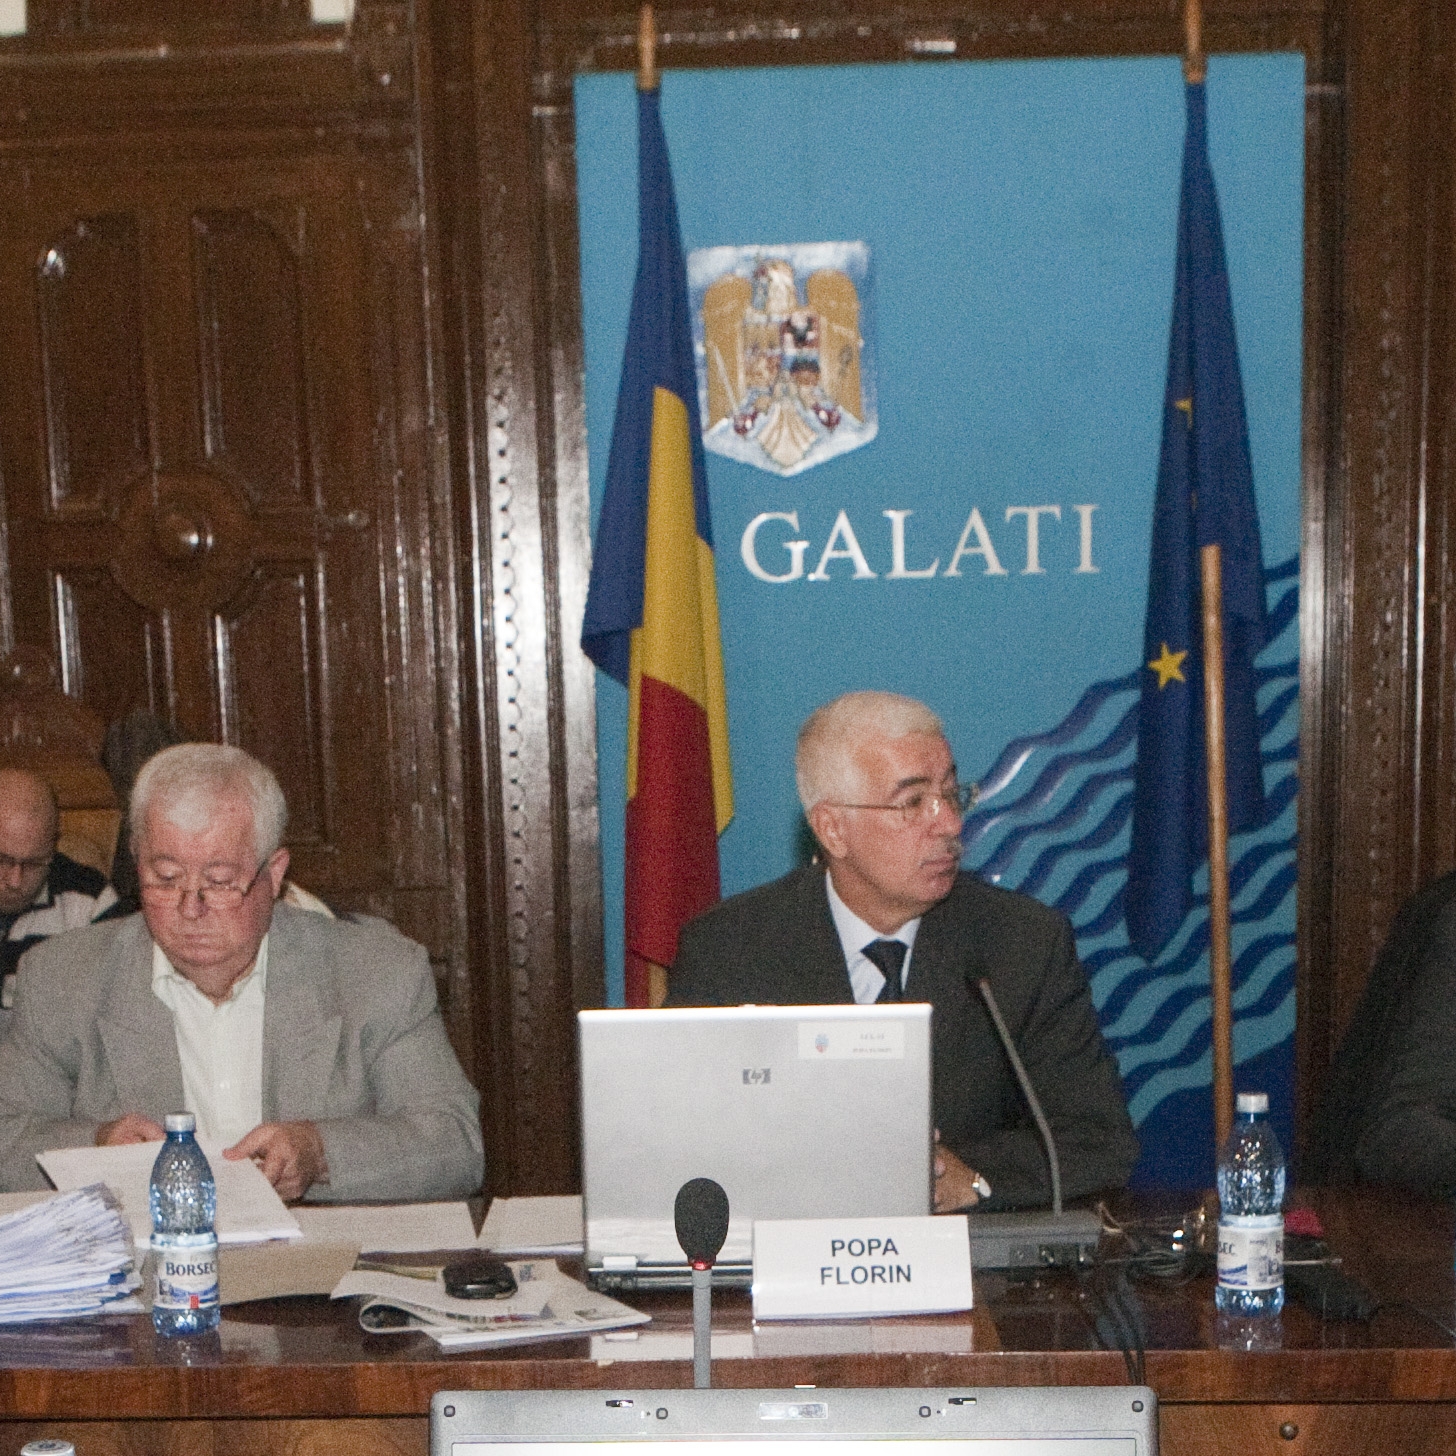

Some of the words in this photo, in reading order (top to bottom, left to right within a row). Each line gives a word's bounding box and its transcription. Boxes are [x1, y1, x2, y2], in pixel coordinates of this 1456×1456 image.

[741, 505, 1100, 583] GALATI
[830, 1238, 899, 1259] POPA
[820, 1264, 912, 1286] FLORIN
